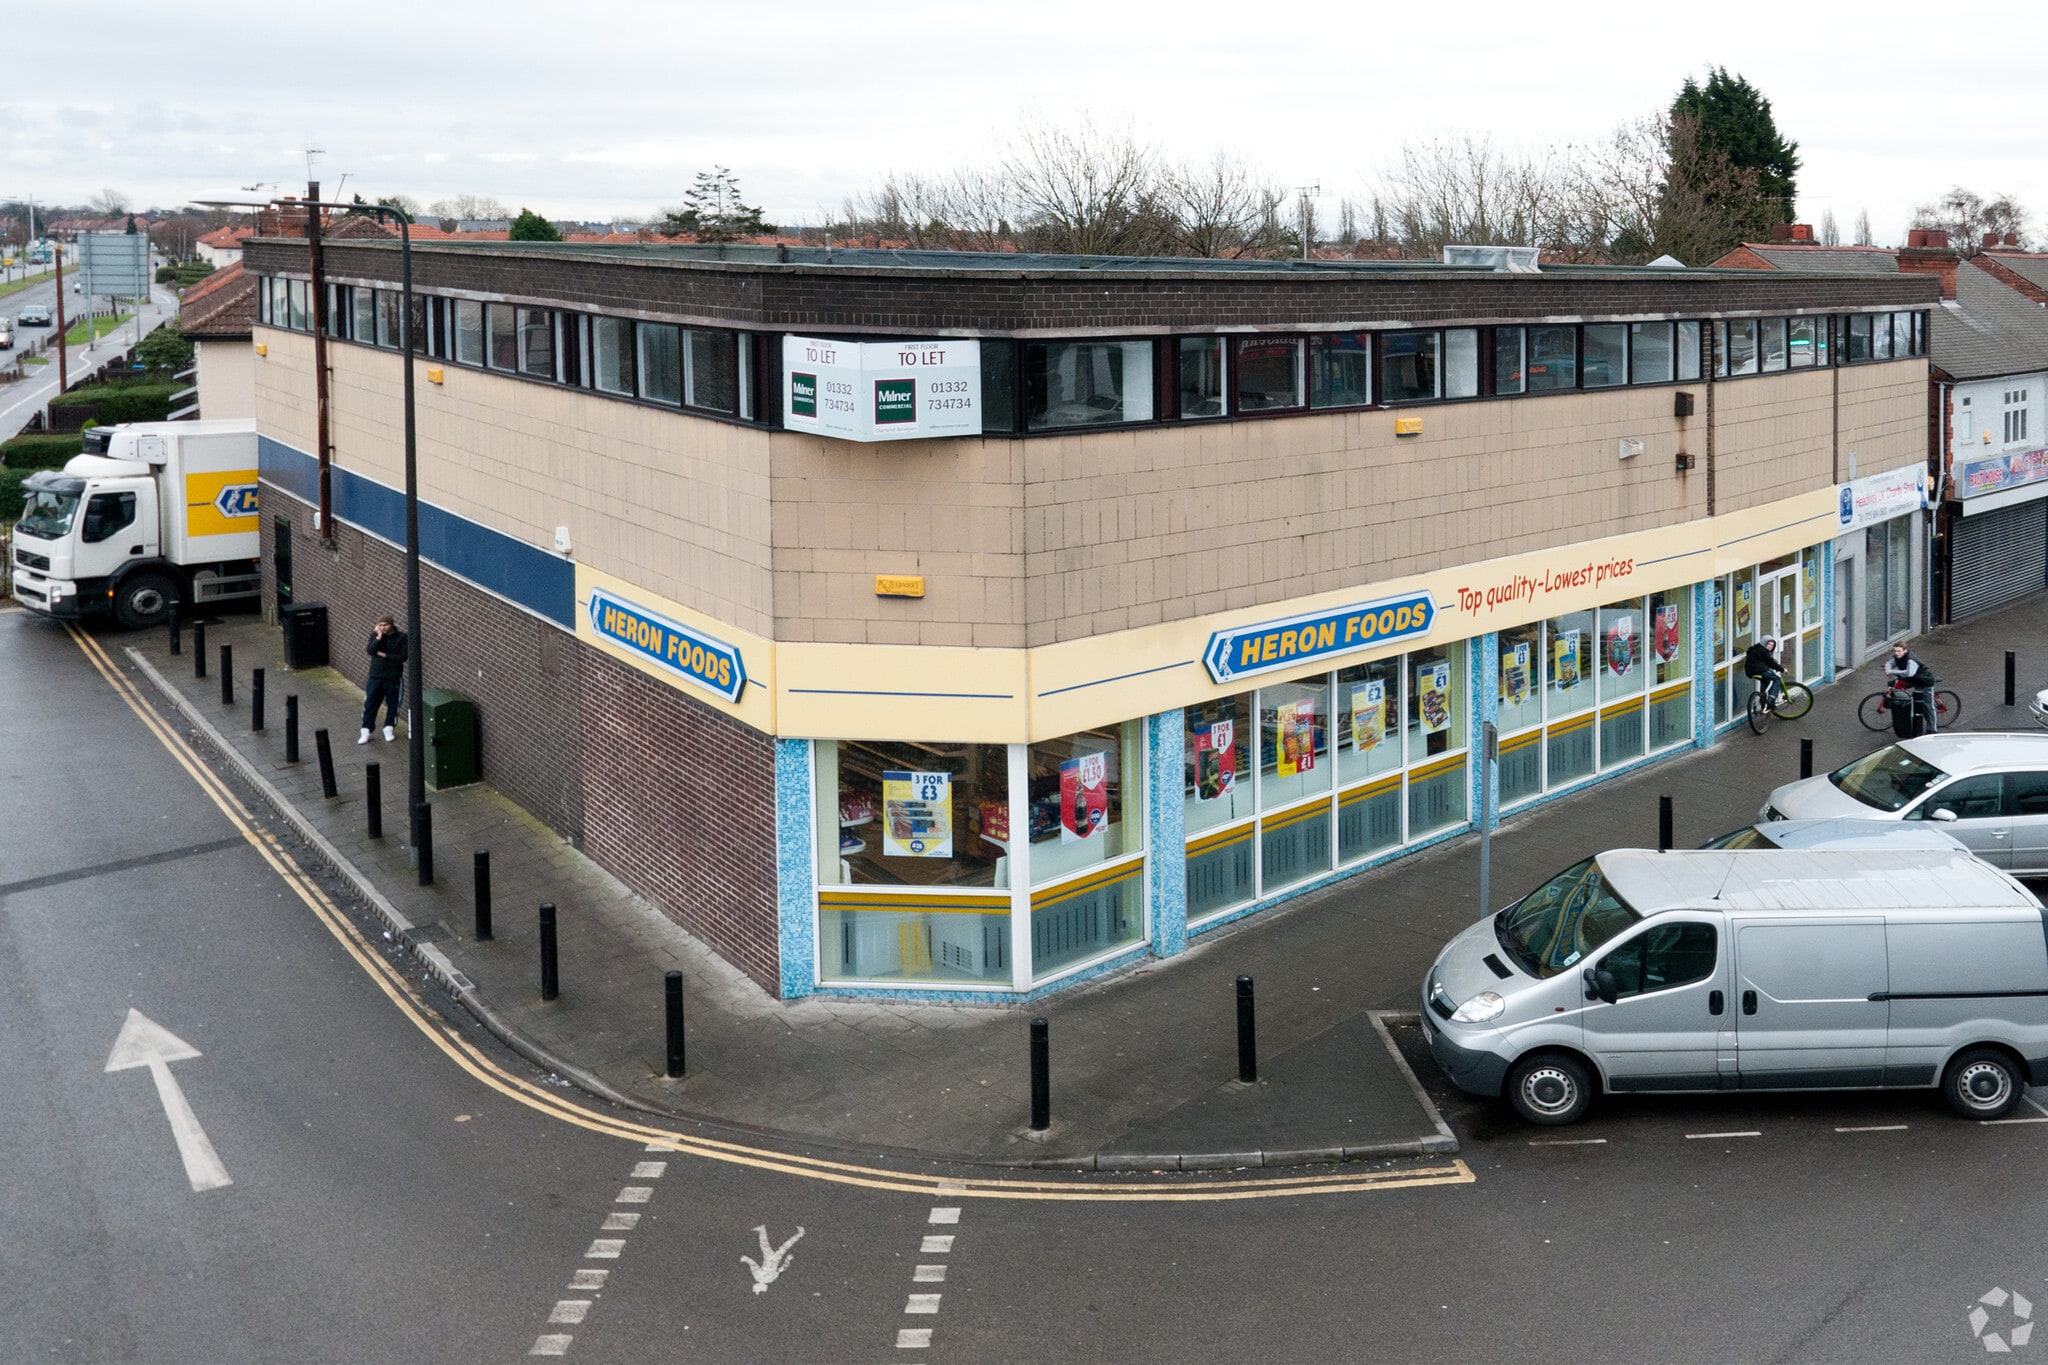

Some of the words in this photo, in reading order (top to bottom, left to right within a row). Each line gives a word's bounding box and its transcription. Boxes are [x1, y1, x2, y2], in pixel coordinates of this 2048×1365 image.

[806, 348, 818, 362] TO
[821, 349, 837, 364] LET
[898, 352, 916, 366] TO
[922, 351, 946, 366] LET
[794, 382, 814, 396] Milner
[826, 381, 852, 395] 01332
[931, 381, 968, 393] 01332
[878, 390, 912, 402] Milner
[825, 398, 855, 413] 734734
[928, 398, 971, 410] 734734
[1458, 587, 1482, 617] Top
[1596, 557, 1633, 590] prices
[1240, 621, 1337, 666] HERON
[1344, 602, 1427, 643] FOODS
[604, 606, 662, 655] HERON
[667, 634, 731, 686] FOODS
[1436, 675, 1447, 688] £1
[1368, 687, 1382, 702] £2
[1218, 723, 1230, 733] FOR
[1217, 733, 1226, 748] £1
[1088, 756, 1098, 766] FOR
[1301, 756, 1311, 770] £1
[915, 774, 920, 784] 3
[922, 775, 944, 785] FOR
[1082, 765, 1102, 783] £1.50
[921, 785, 938, 801] £3
